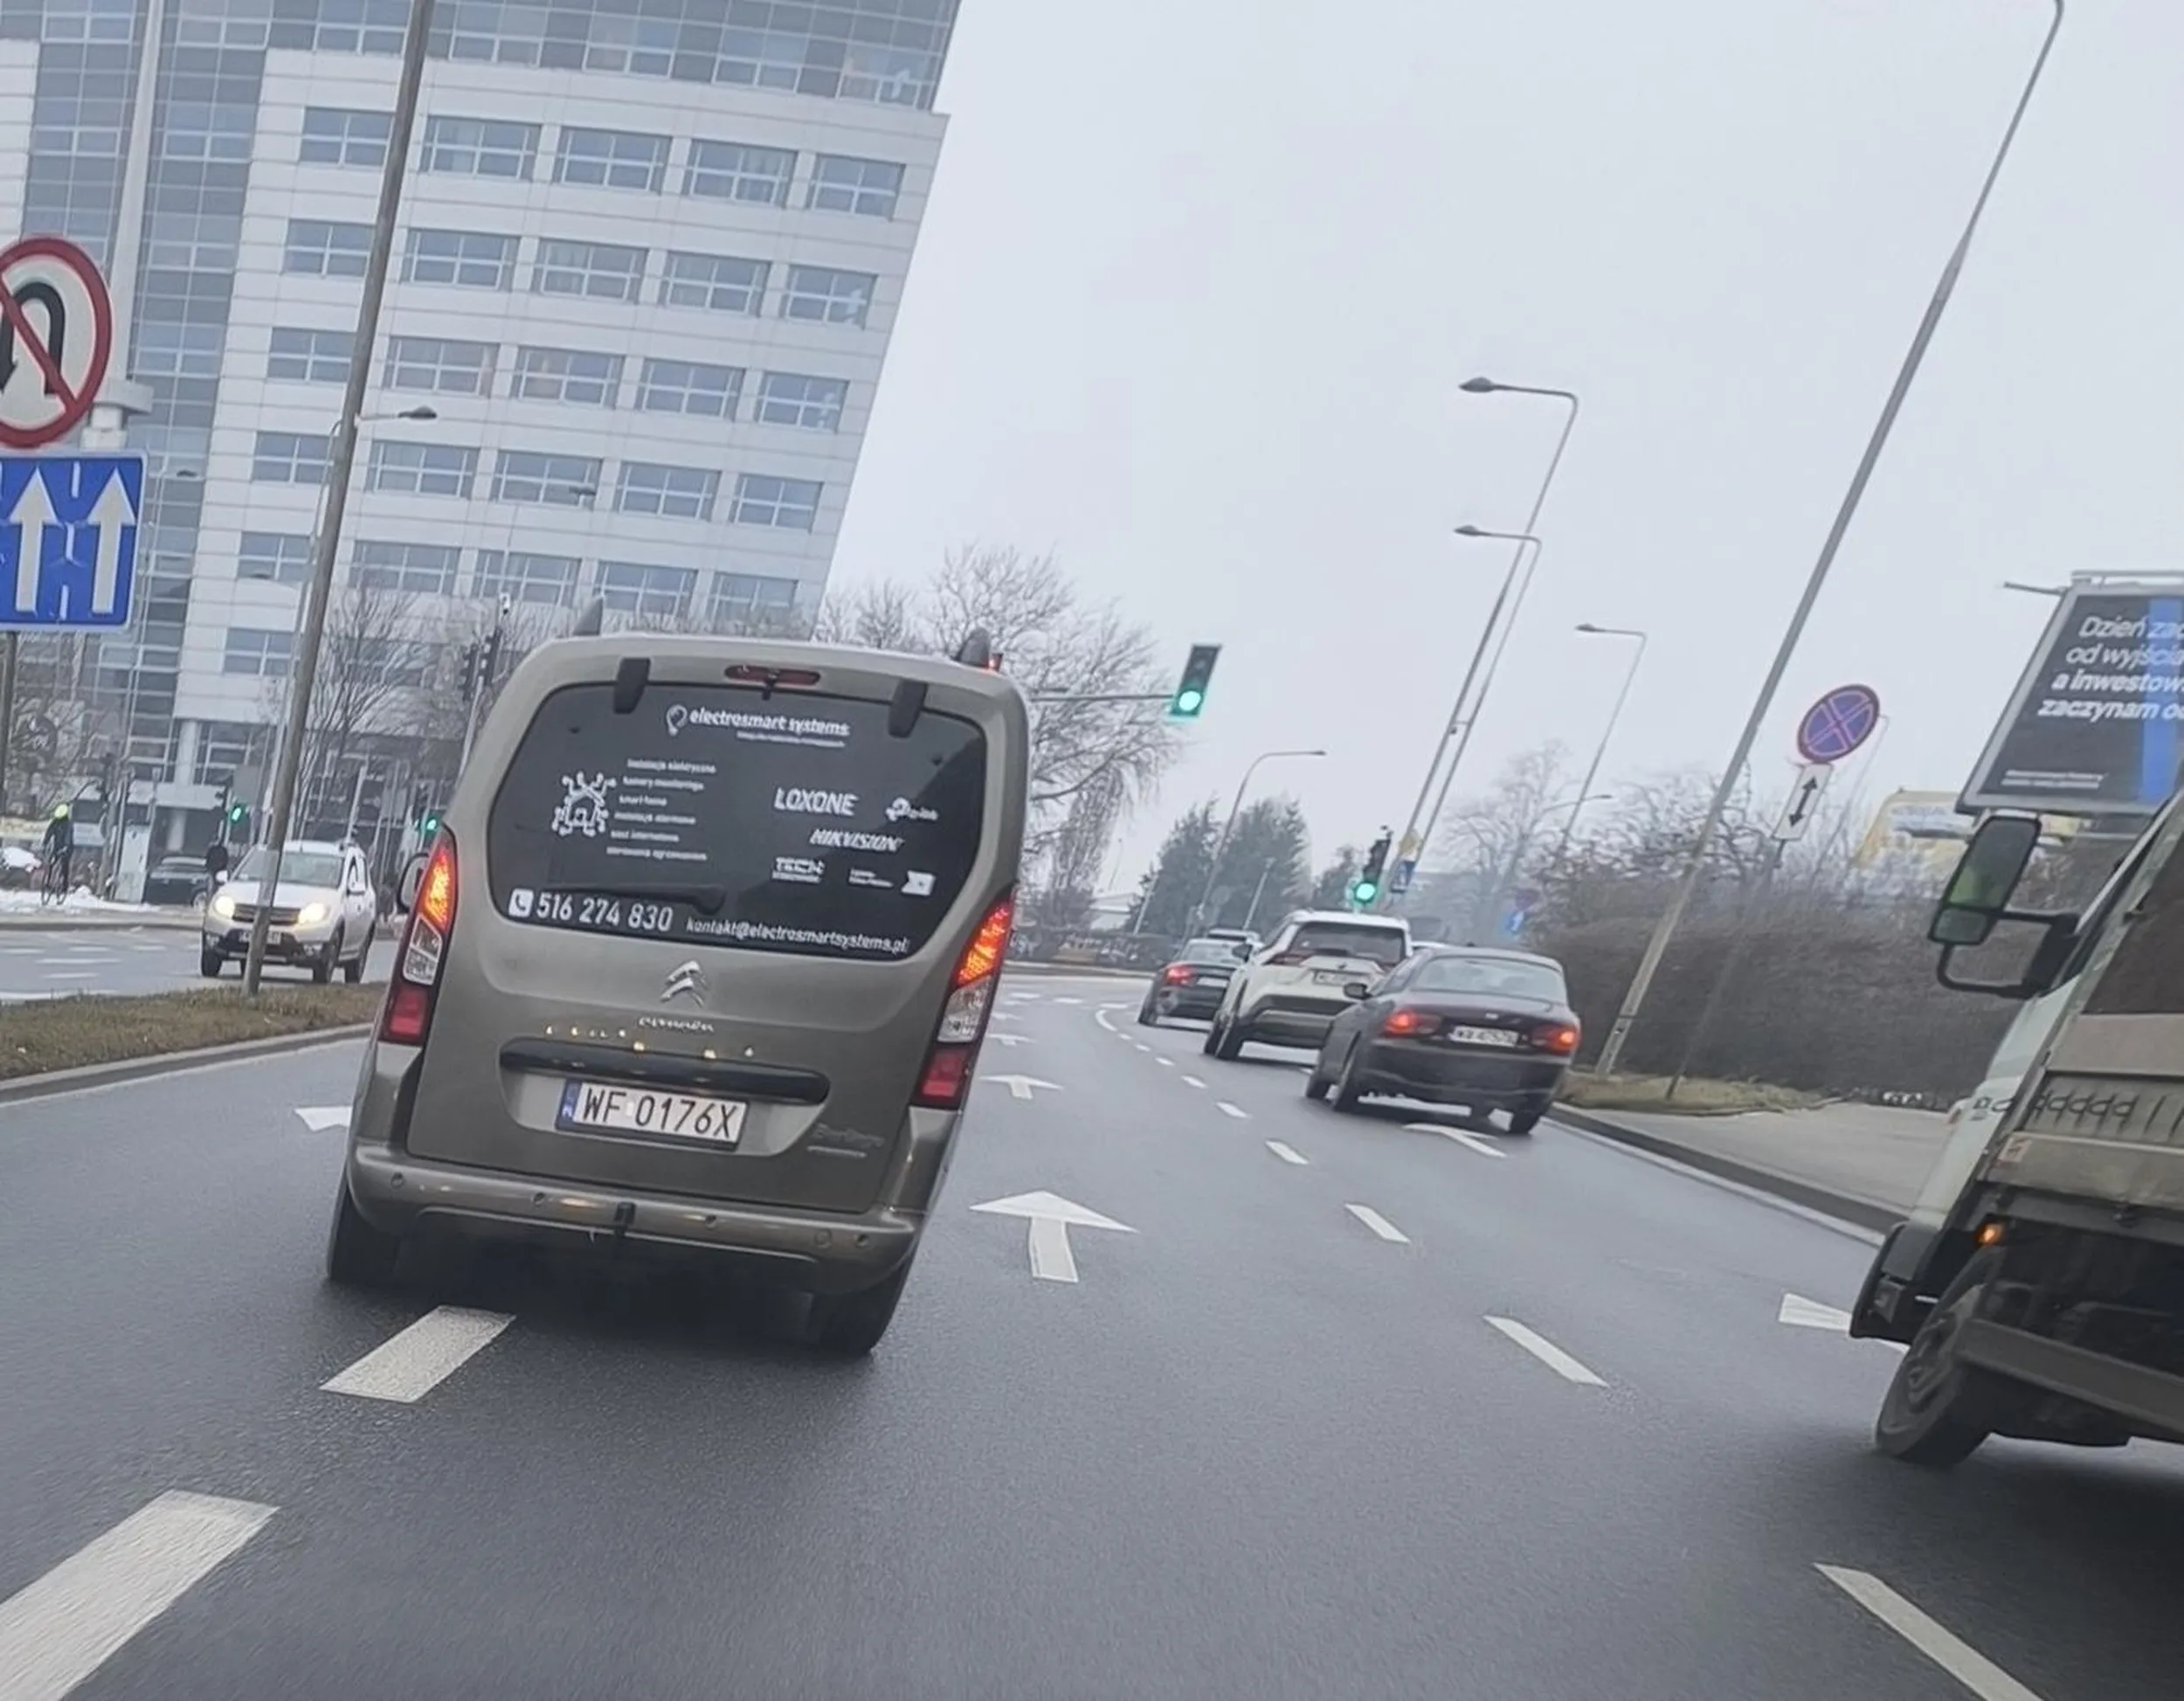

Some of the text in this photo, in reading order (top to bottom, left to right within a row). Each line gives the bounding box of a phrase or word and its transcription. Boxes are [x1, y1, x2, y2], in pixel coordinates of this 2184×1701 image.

[2078, 615, 2148, 639] Dzień
[2065, 643, 2104, 664] od
[2051, 668, 2184, 692] a inwestow
[689, 706, 851, 737] electrosmart systems
[2037, 699, 2160, 723] zaczynam
[774, 787, 859, 817] LOXONE
[810, 828, 904, 853] HIKVISION
[536, 891, 674, 932] 516 274 830
[685, 916, 909, 954] kontakt@electrosmartsystems.pl
[583, 1087, 738, 1138] WF 0176X
